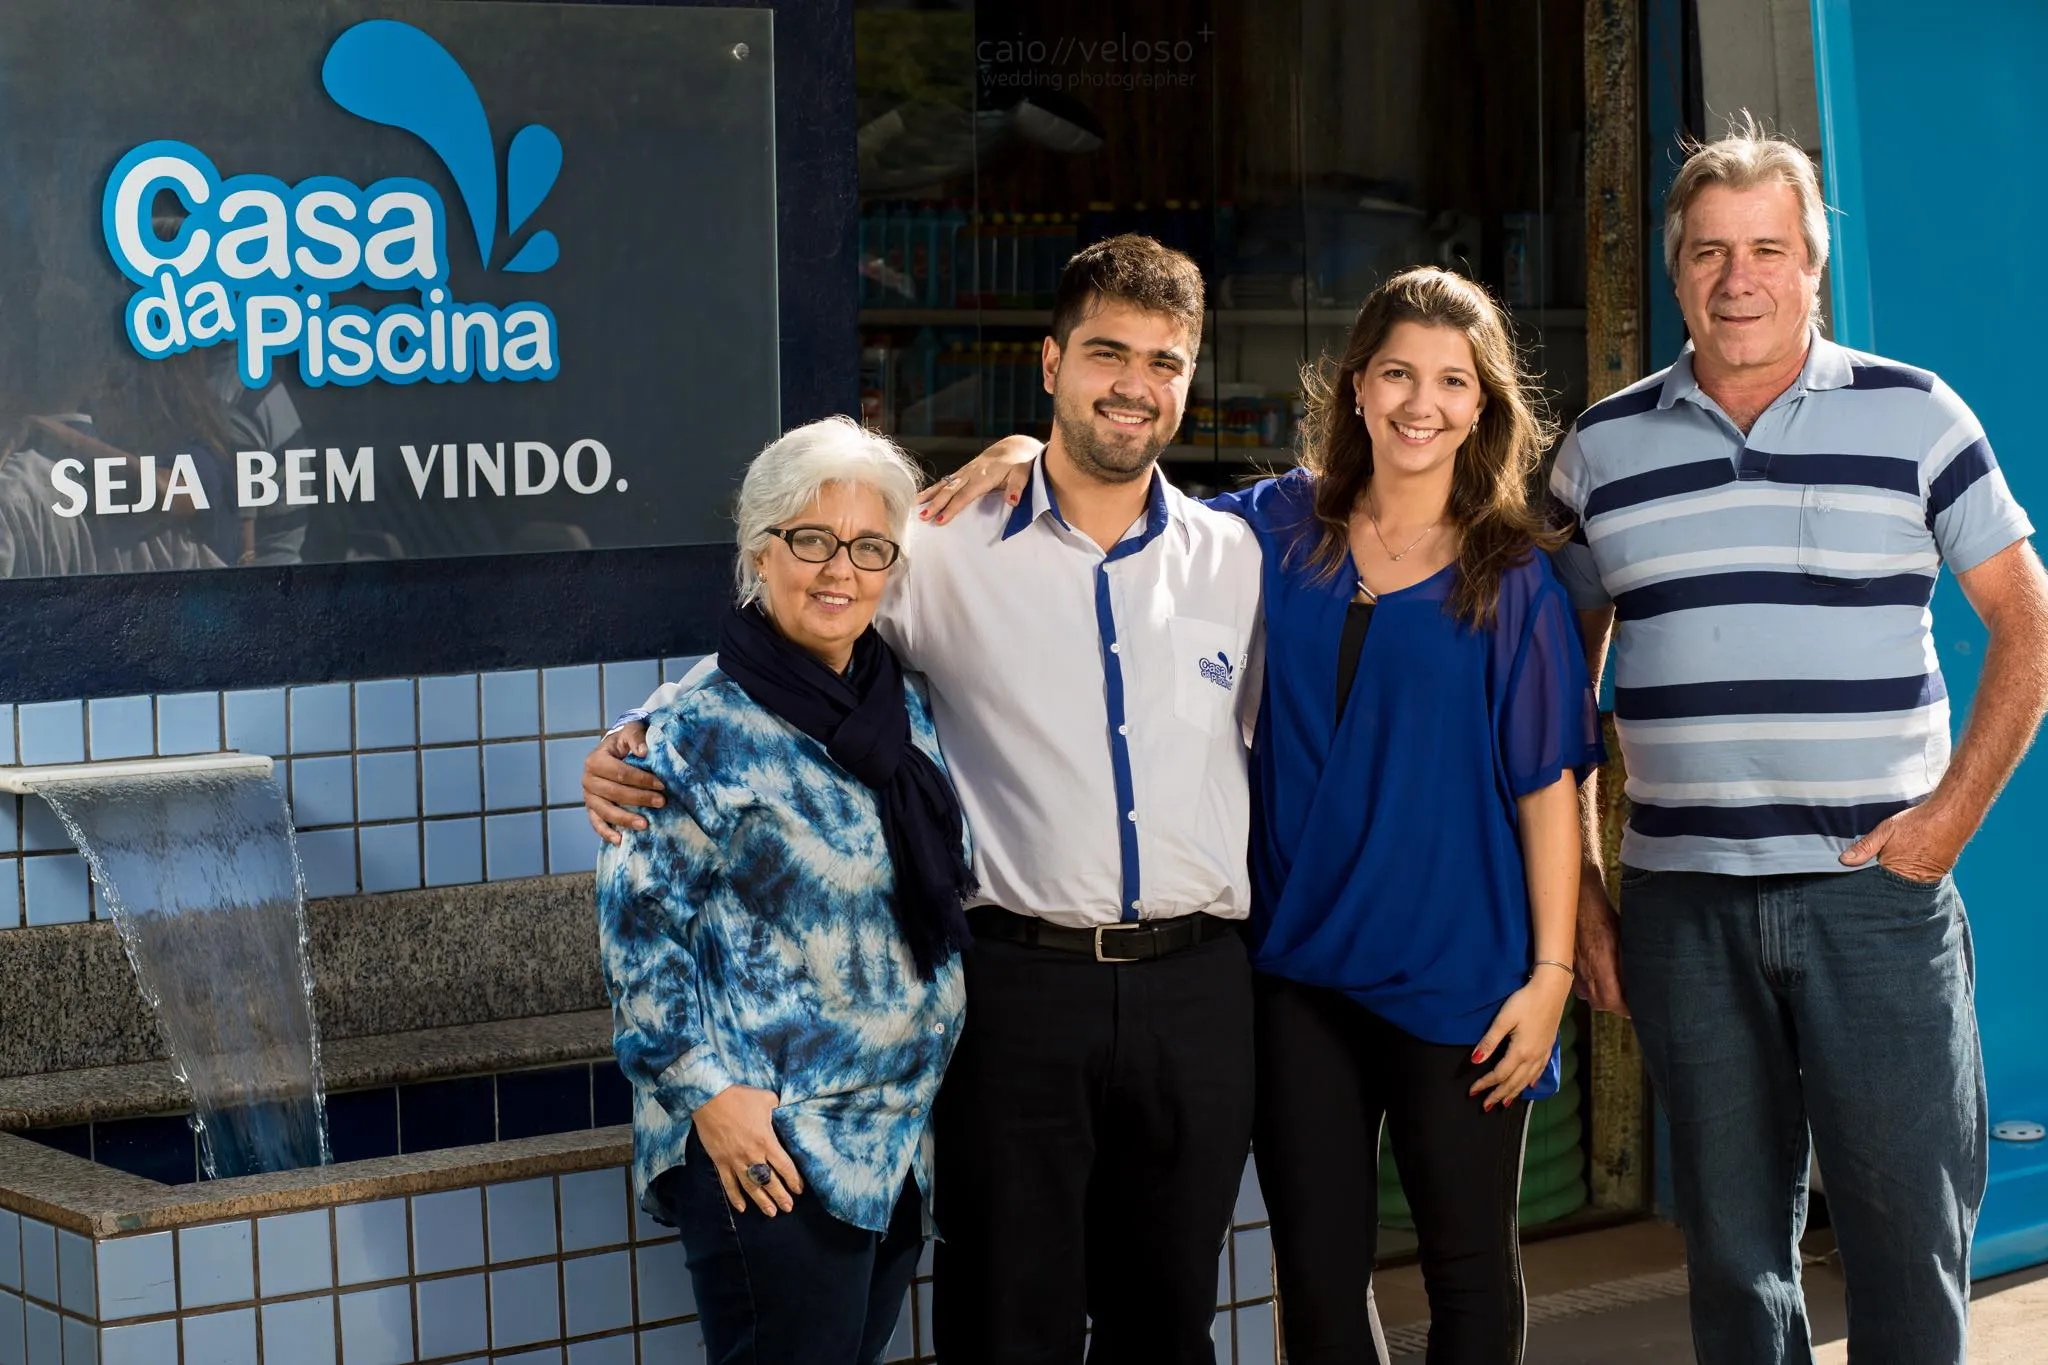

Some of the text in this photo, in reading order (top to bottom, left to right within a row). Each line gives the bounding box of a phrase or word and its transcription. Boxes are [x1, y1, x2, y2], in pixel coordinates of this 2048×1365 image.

[115, 156, 437, 280] Casa
[133, 272, 553, 380] da Piscina
[51, 438, 628, 518] SEJA BEM VINDO.
[1199, 658, 1226, 678] Casa
